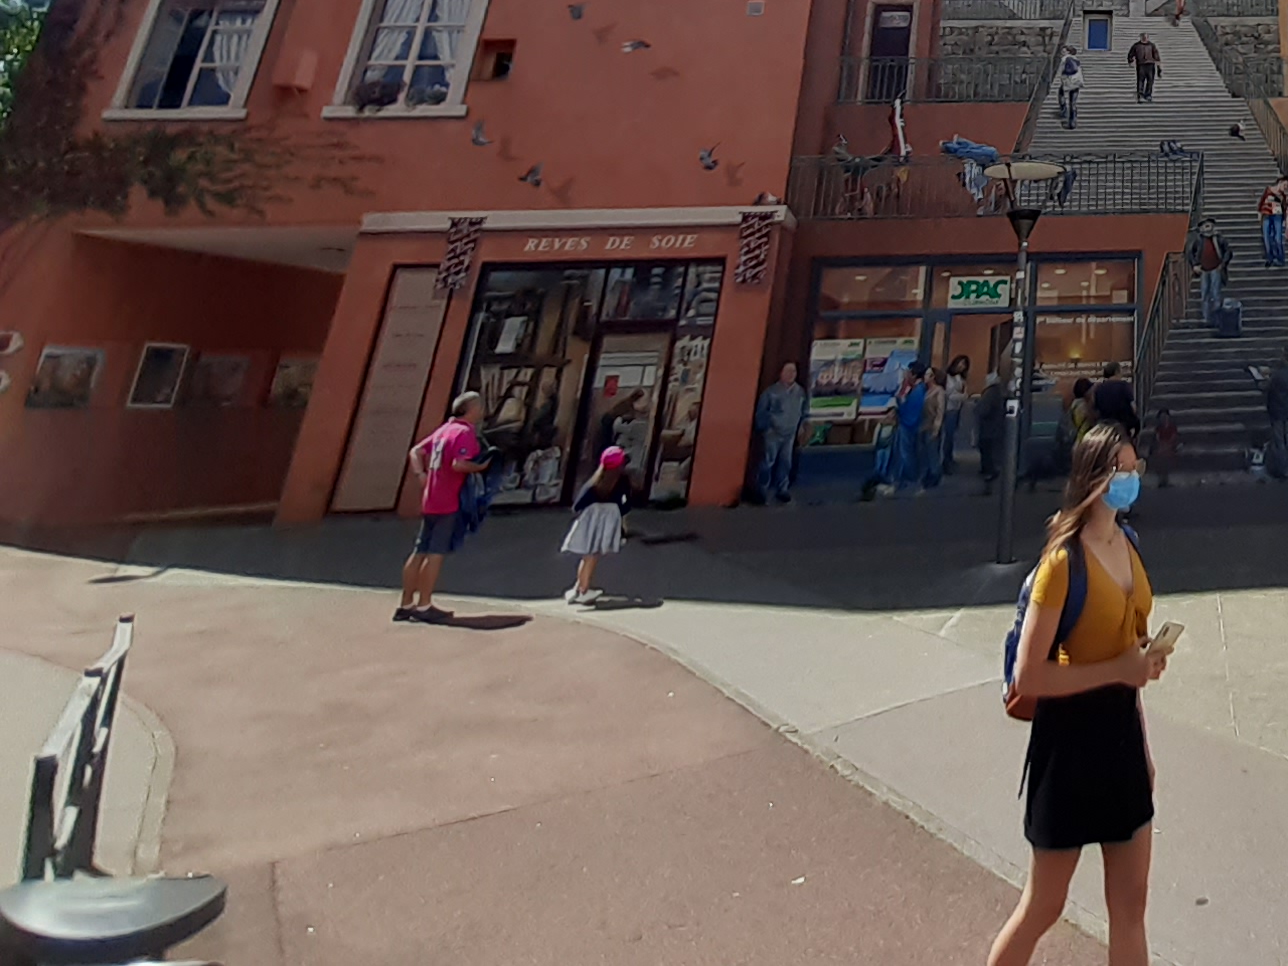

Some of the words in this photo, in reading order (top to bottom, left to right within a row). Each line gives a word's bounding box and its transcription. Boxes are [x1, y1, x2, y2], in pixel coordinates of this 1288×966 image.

[523, 236, 591, 252] REVES
[605, 236, 634, 250] DE
[650, 234, 698, 249] SOIE
